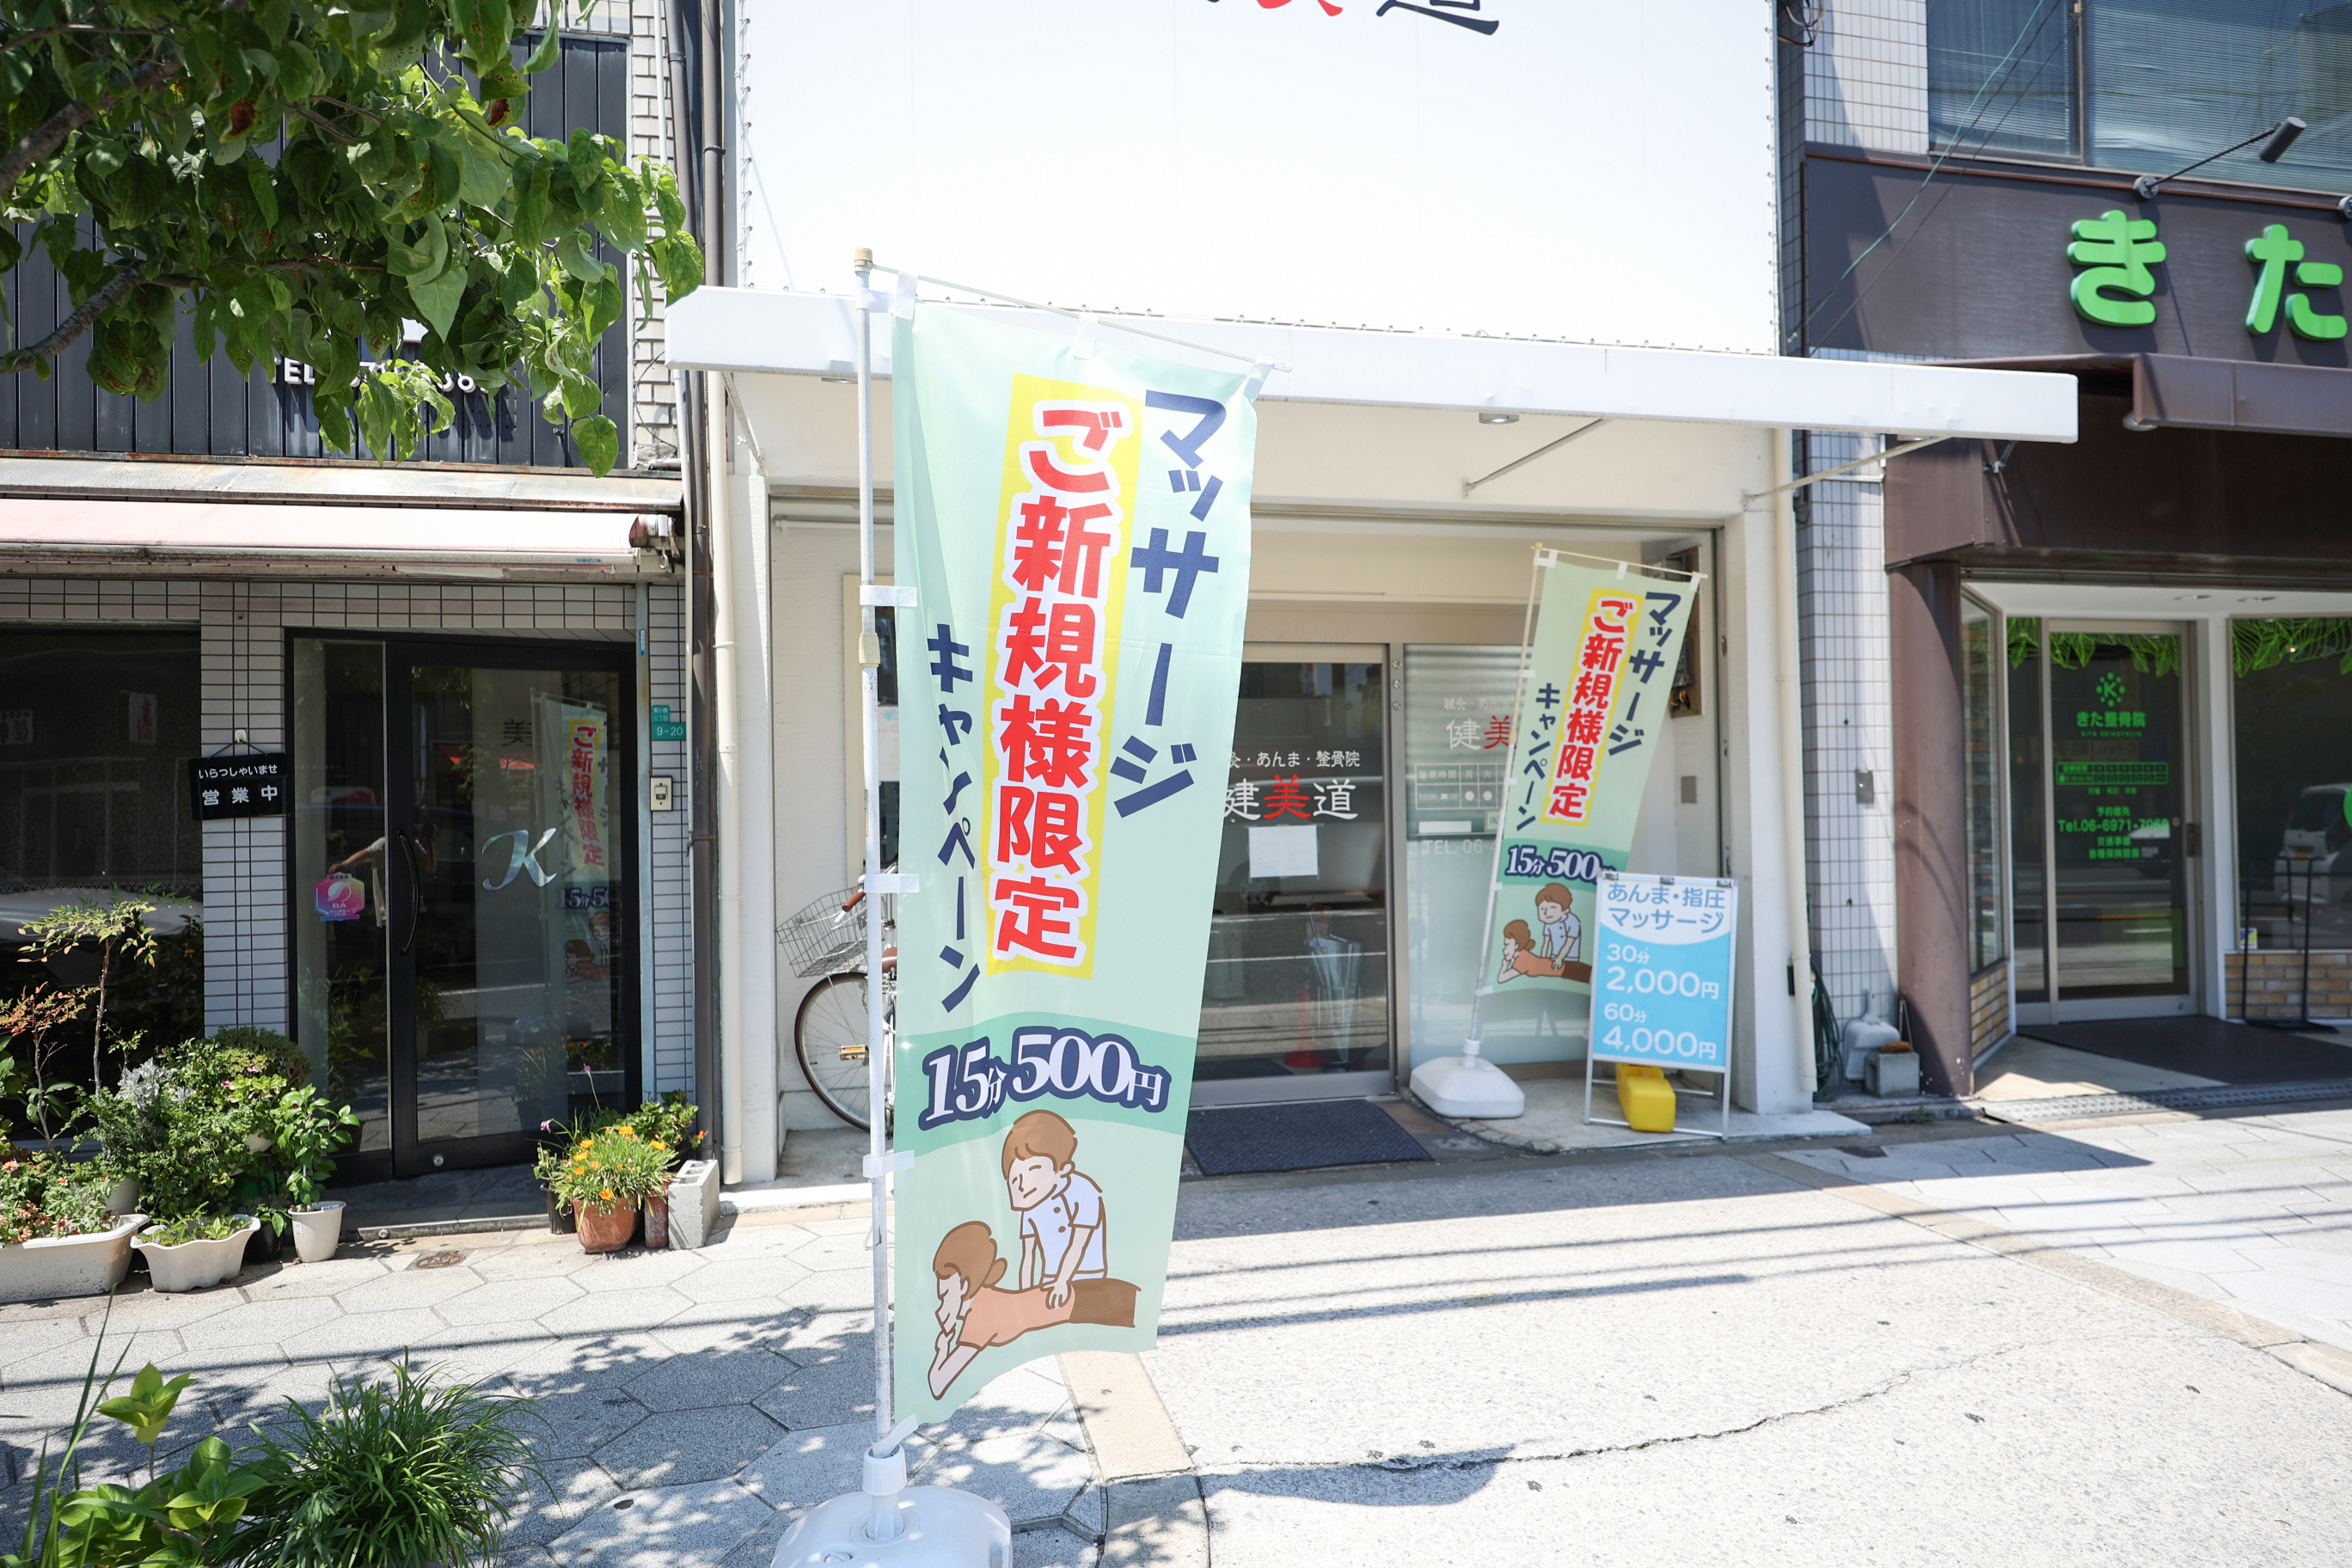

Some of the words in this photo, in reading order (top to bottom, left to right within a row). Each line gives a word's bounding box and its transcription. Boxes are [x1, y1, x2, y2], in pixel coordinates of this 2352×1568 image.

[2067, 210, 2349, 341] きた
[1110, 389, 1227, 818] マッサージ
[995, 409, 1123, 959] ご新規様限定
[1608, 591, 1681, 756] マッサージ
[1549, 600, 1633, 818] ご新規様限定
[656, 726, 683, 736] 9-20
[198, 763, 278, 779] いらっしゃいませ
[1466, 769, 1473, 779] 月
[1516, 683, 1560, 831] キャンペーン
[202, 785, 278, 806] 営業中
[927, 623, 980, 1013] キャンペーン
[1506, 845, 1615, 884] 15分500
[1607, 882, 1726, 910] あんま・指圧
[1608, 907, 1724, 934] マッサージ
[1607, 943, 1651, 965] 30分
[1606, 965, 1719, 1000] 2,000円
[1603, 1002, 1648, 1023] 60分
[1602, 1025, 1718, 1061] 4,000円
